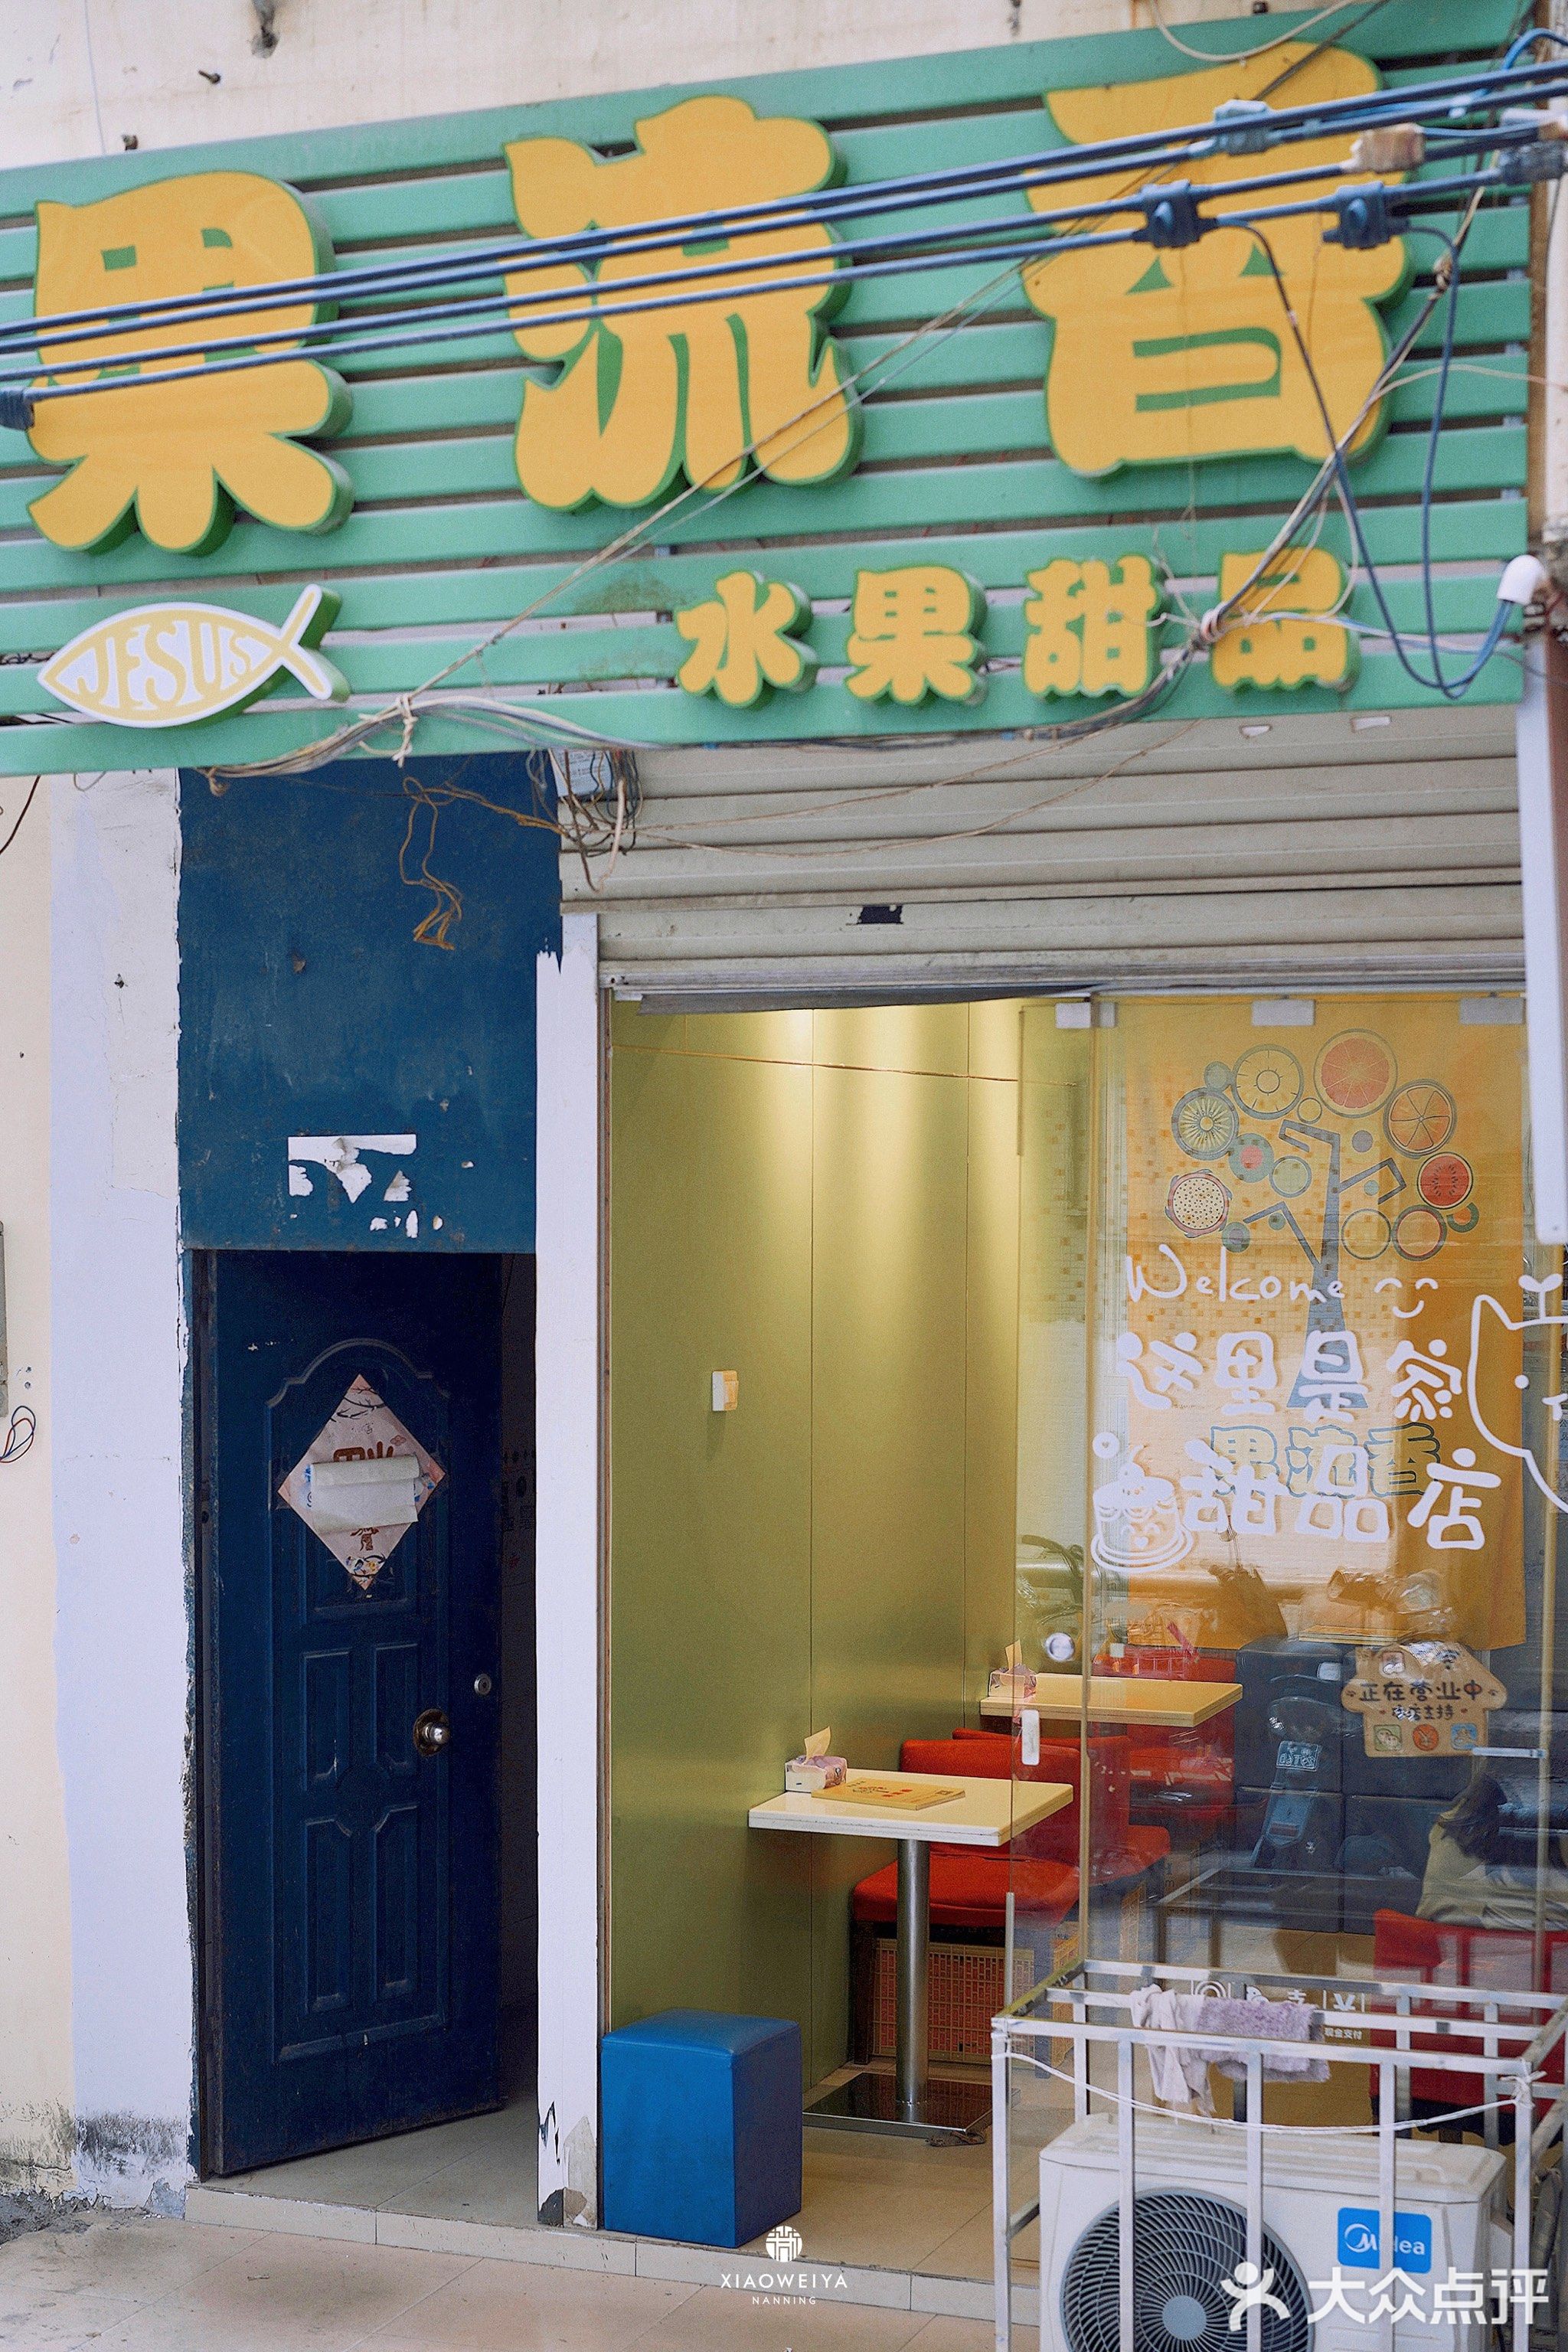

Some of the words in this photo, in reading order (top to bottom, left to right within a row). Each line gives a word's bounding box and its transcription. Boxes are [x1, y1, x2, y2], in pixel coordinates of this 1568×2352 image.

[28, 40, 1410, 553] 果流香
[75, 619, 253, 710] JESUS
[678, 548, 1354, 707] 水果甜品
[1125, 1244, 1344, 1302] Welcome
[1180, 1438, 1501, 1550] 甜品店
[1359, 1679, 1483, 1701] 正在营业中
